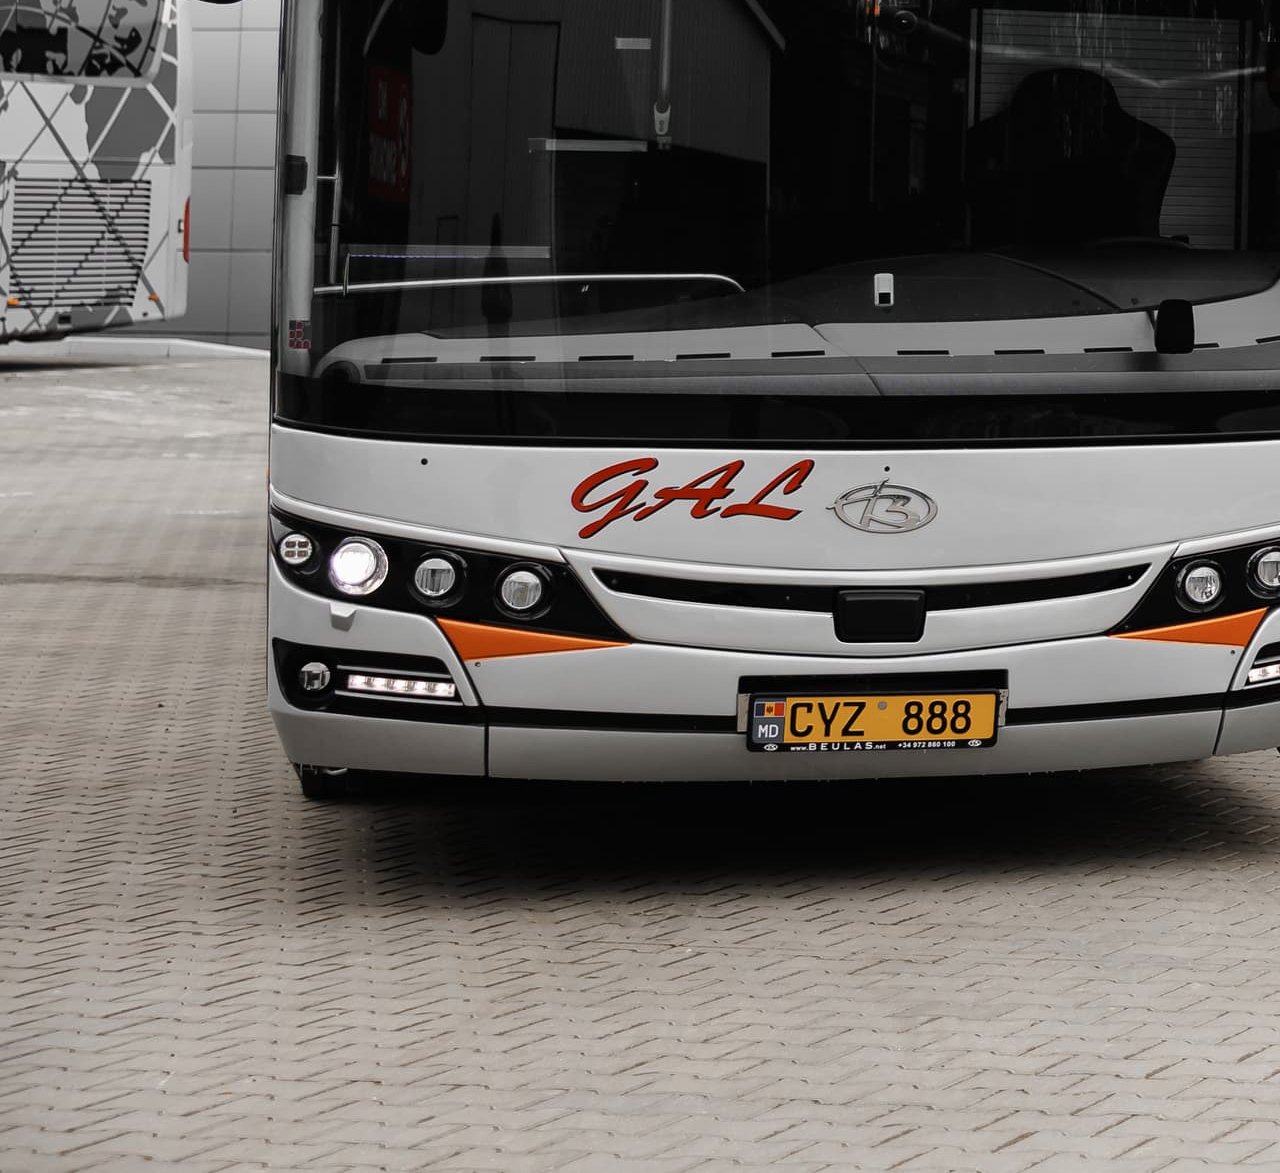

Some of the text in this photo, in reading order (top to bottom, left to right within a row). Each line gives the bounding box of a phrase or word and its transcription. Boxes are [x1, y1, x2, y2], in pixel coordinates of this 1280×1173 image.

[570, 456, 815, 540] GAL
[757, 724, 779, 738] MD
[789, 699, 972, 738] CYZ 888
